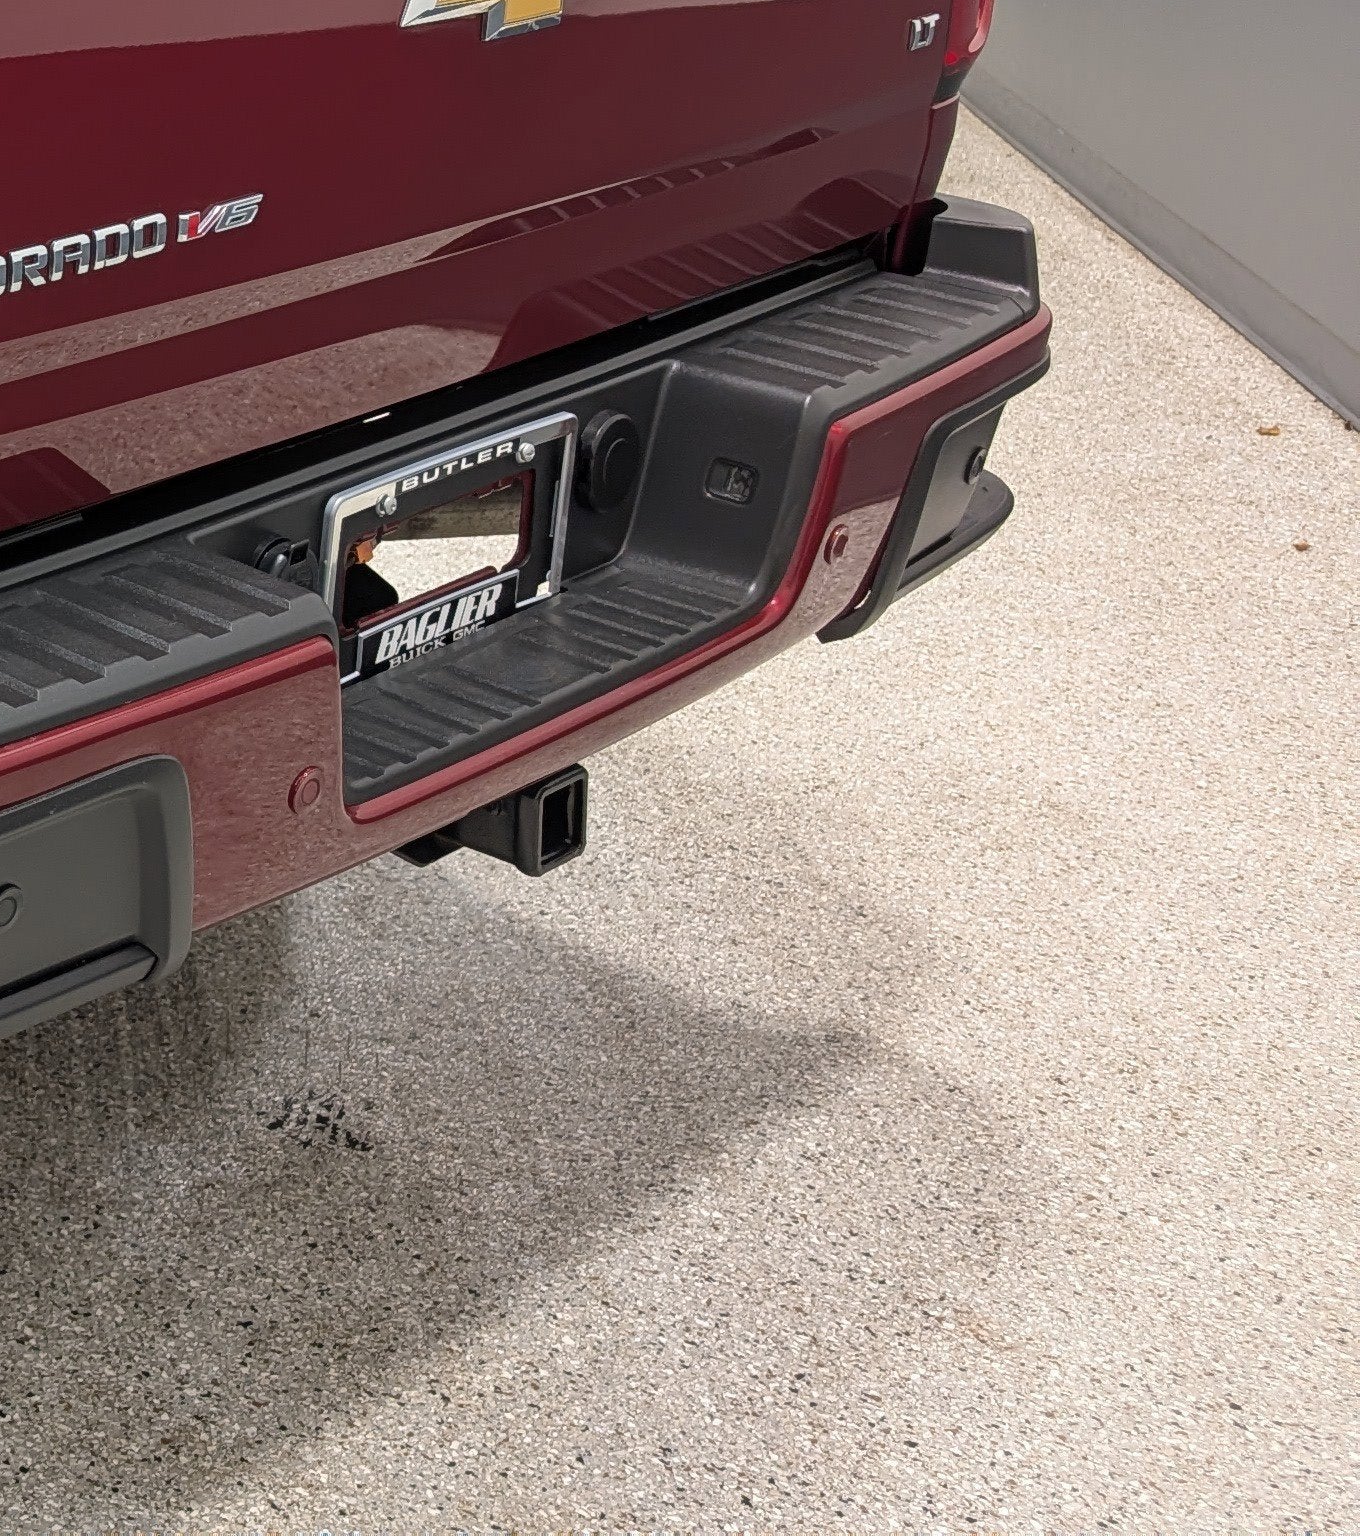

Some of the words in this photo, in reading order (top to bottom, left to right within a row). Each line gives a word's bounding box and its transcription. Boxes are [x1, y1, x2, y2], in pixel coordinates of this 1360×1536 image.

[908, 12, 941, 52] LT
[176, 193, 265, 244] V6
[400, 440, 516, 493] BUTLER
[374, 583, 504, 666] BAGLIER
[386, 636, 448, 671] BUICK
[452, 619, 487, 641] GMC
